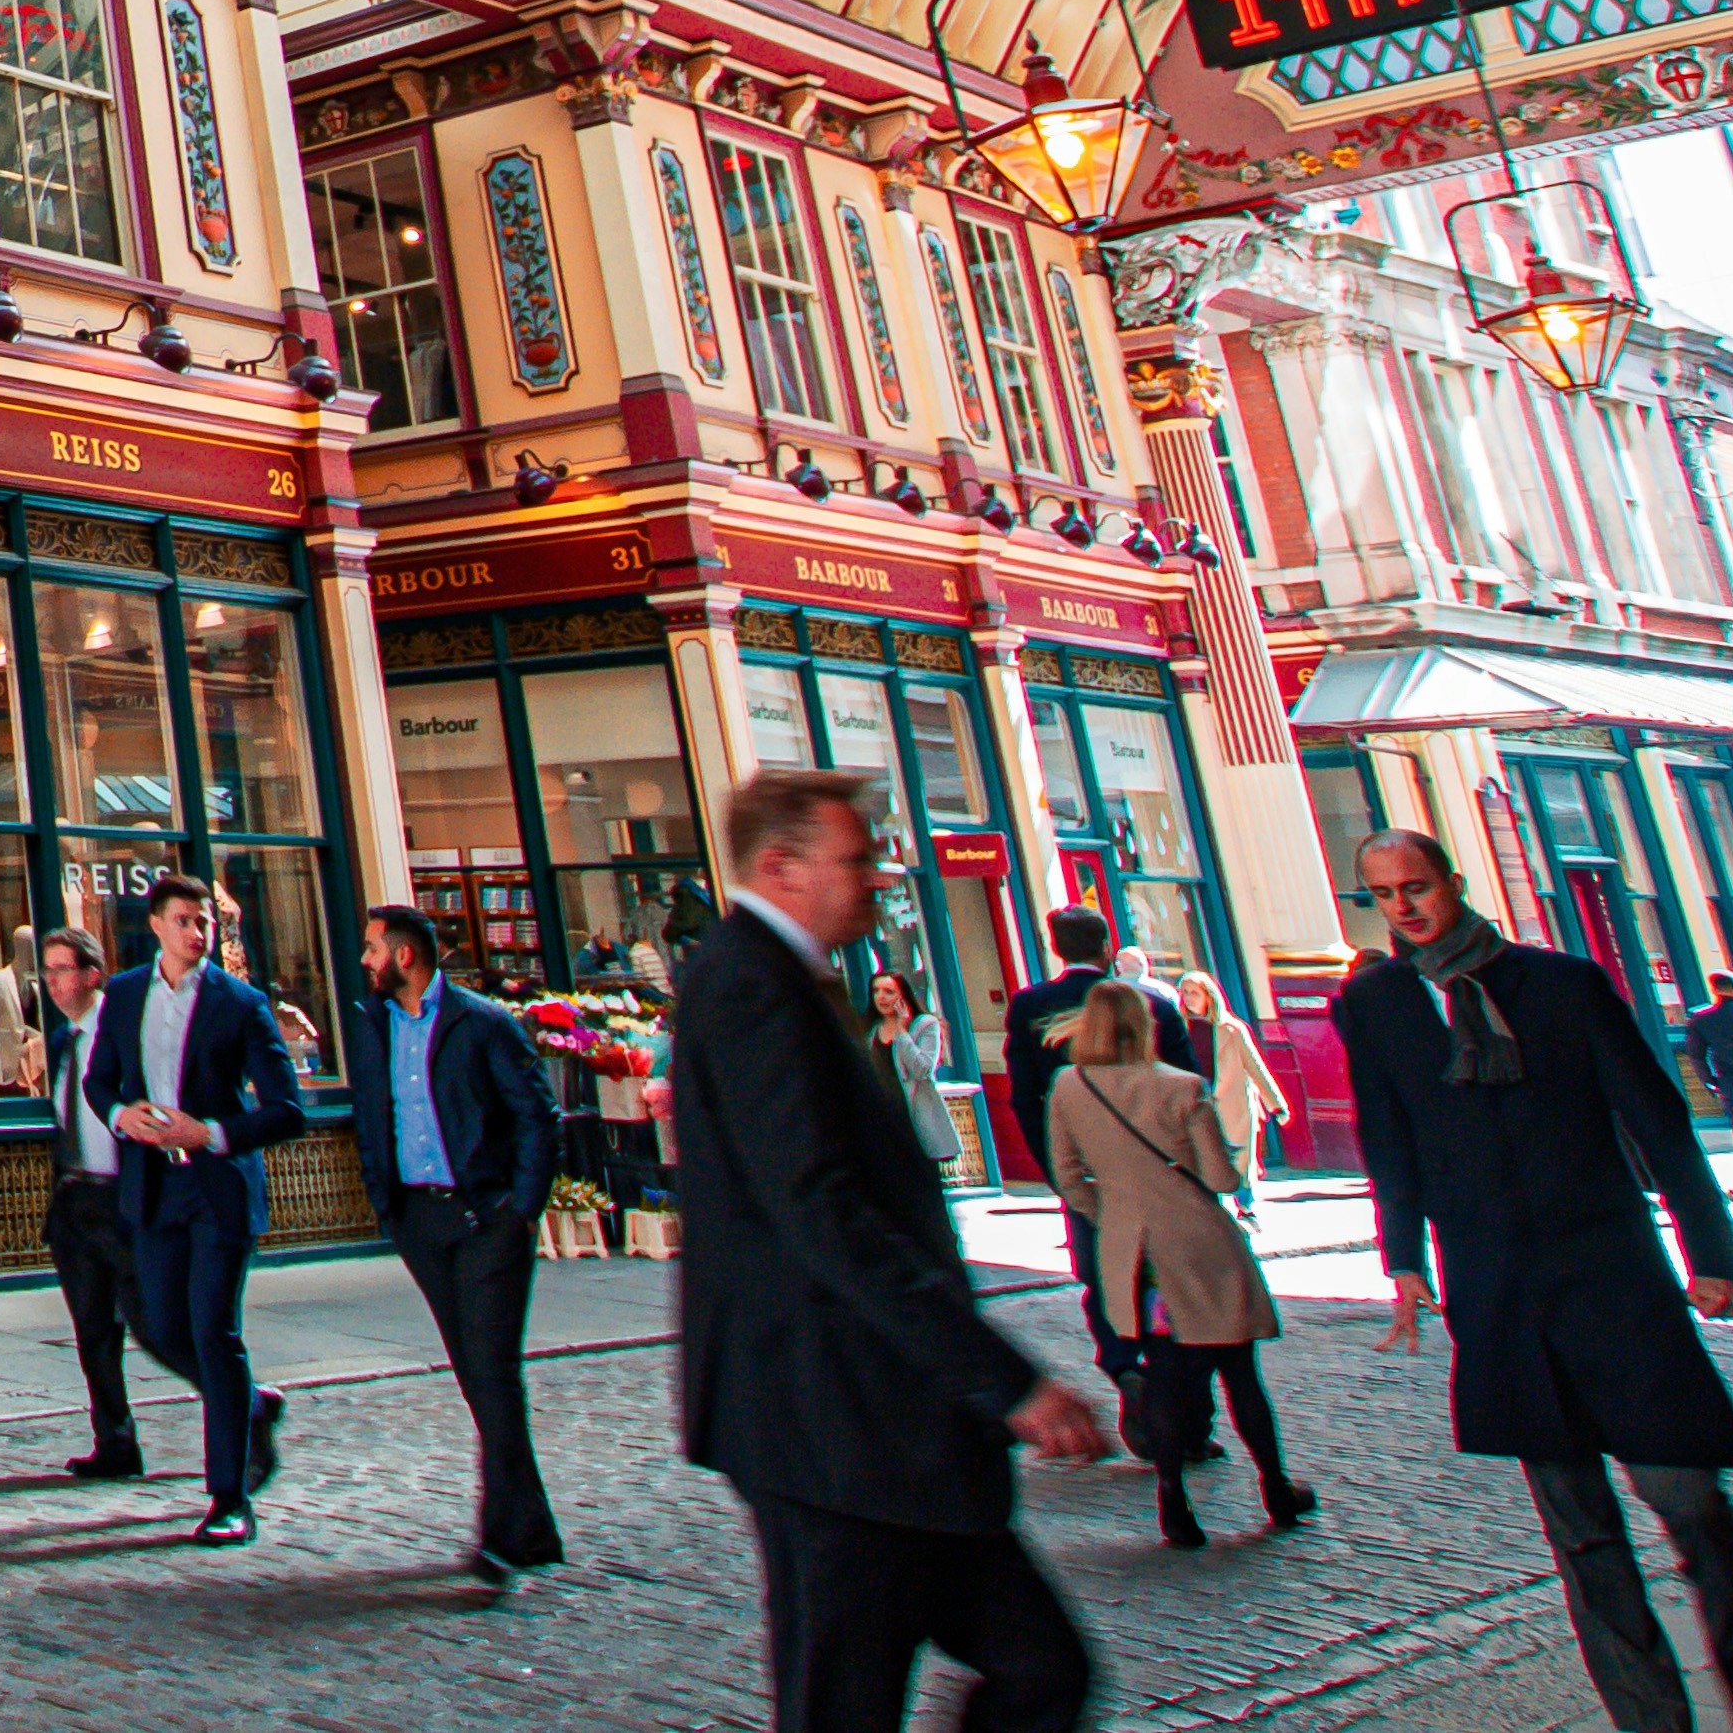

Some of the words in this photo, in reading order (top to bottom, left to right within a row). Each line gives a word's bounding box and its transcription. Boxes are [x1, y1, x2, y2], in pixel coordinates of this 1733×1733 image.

[50, 430, 141, 472] REISS
[267, 469, 296, 498] 26
[368, 562, 494, 597] RBOUR
[610, 545, 643, 571] 31
[795, 556, 892, 593] BARBOUR
[942, 579, 960, 603] 31
[1040, 596, 1120, 630] BARBOUR
[1145, 614, 1160, 636] 31
[400, 717, 479, 736] Barbour
[945, 848, 997, 861] Barbour
